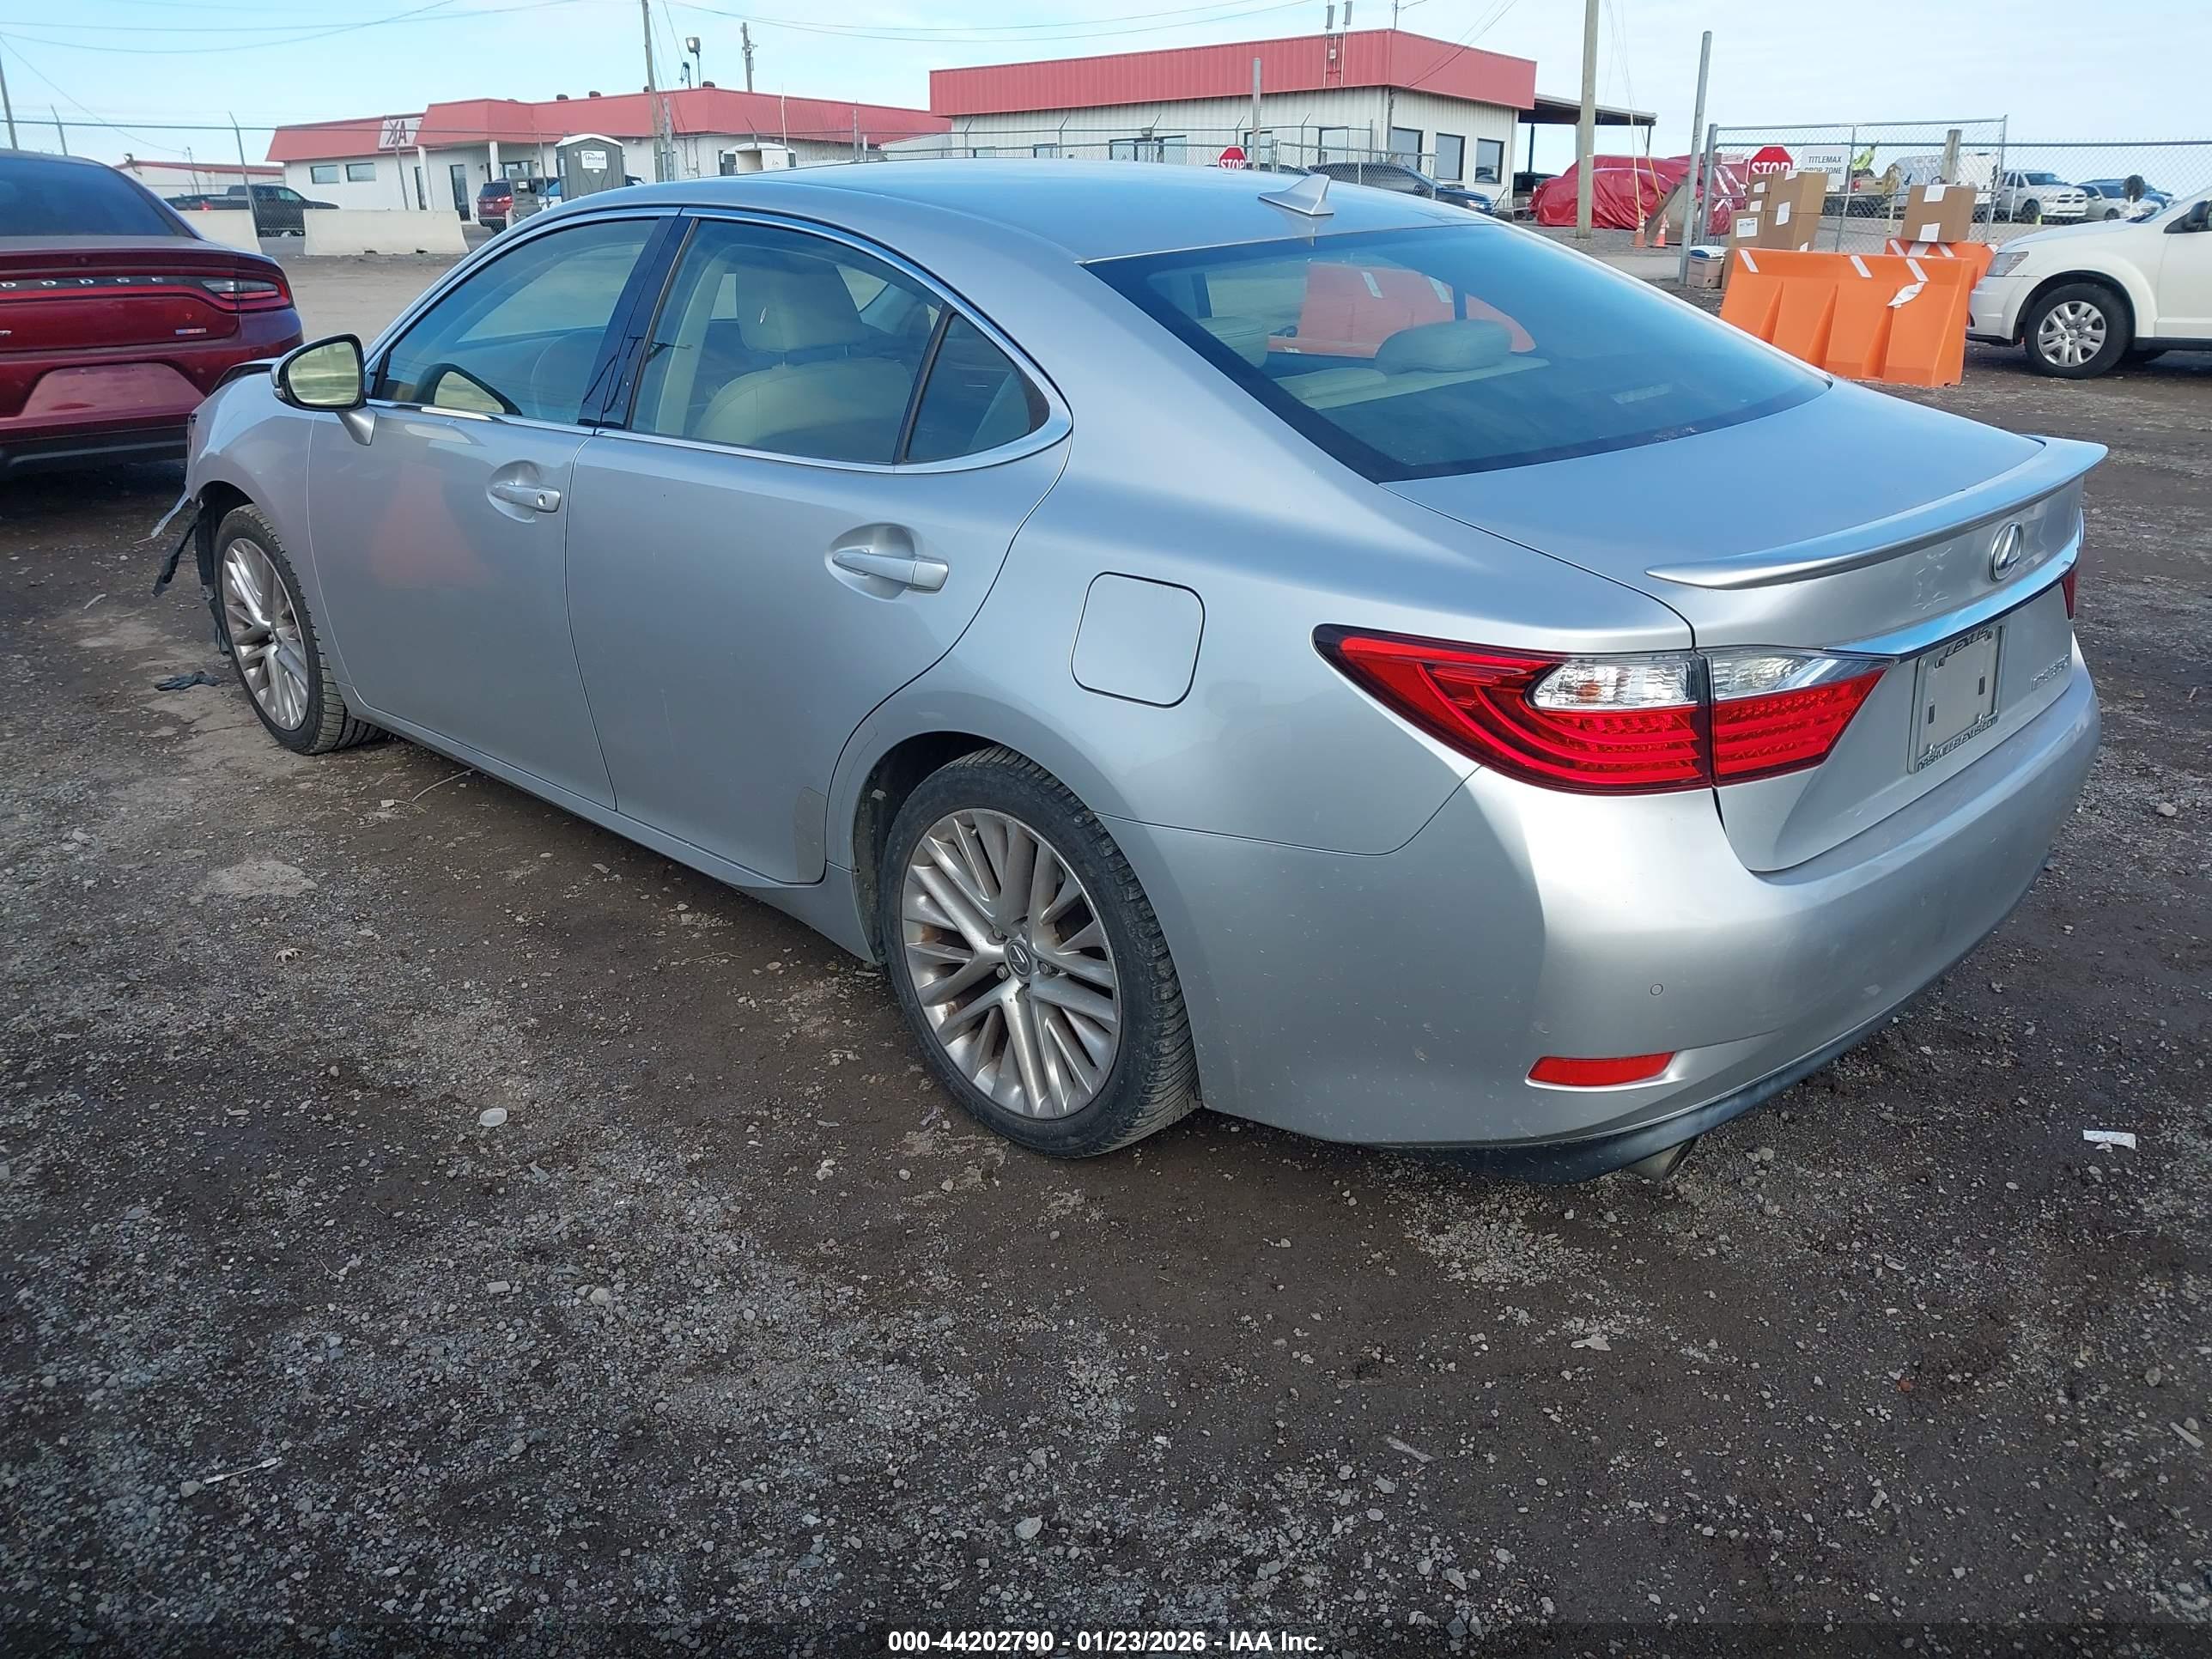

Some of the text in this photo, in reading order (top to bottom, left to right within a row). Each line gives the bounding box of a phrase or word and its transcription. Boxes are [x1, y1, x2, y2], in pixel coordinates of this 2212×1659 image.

[1220, 159, 1245, 169] STOP
[1, 276, 164, 289] DODGE
[1944, 626, 1989, 659] LEXUS
